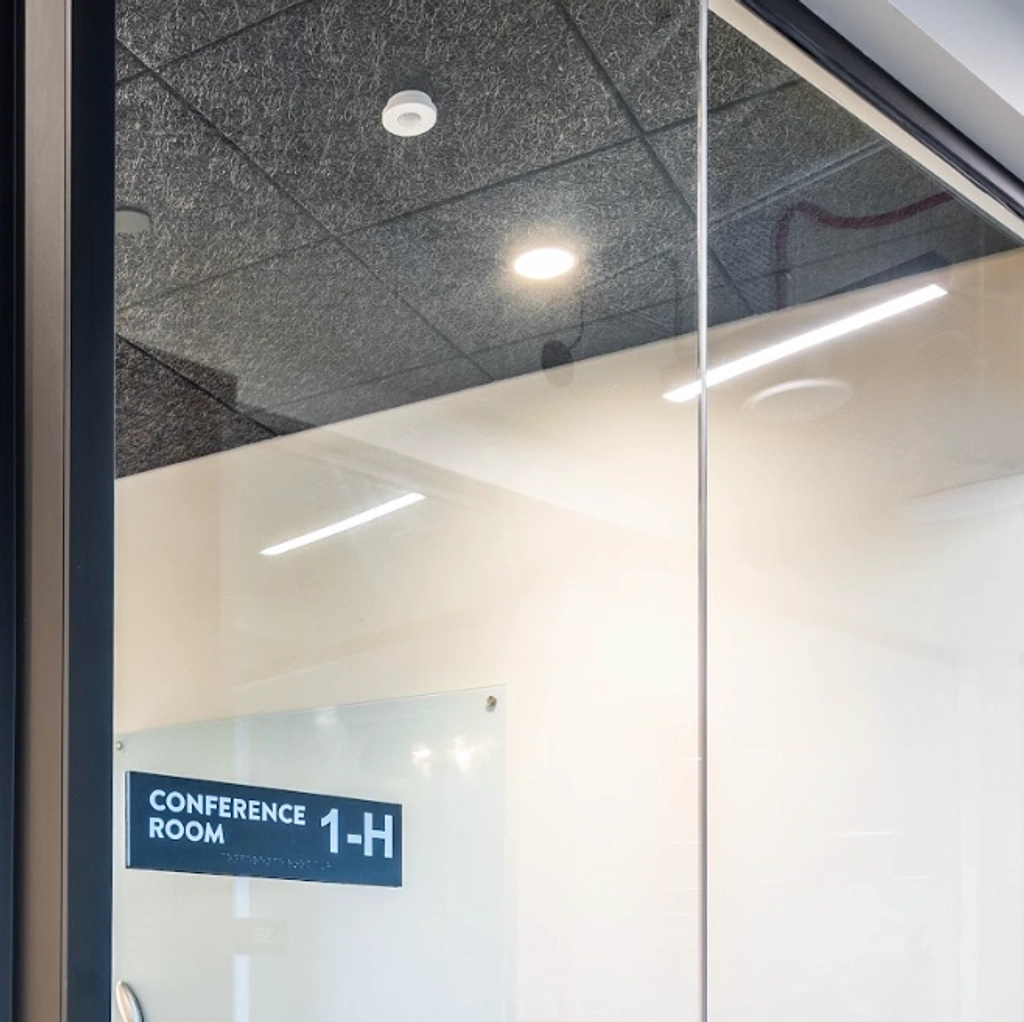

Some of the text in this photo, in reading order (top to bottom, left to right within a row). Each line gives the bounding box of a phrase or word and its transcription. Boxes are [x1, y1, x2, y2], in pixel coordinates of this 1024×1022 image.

[149, 789, 306, 826] CONFERENCE
[149, 816, 225, 845] ROOM
[320, 808, 394, 859] 1-H
